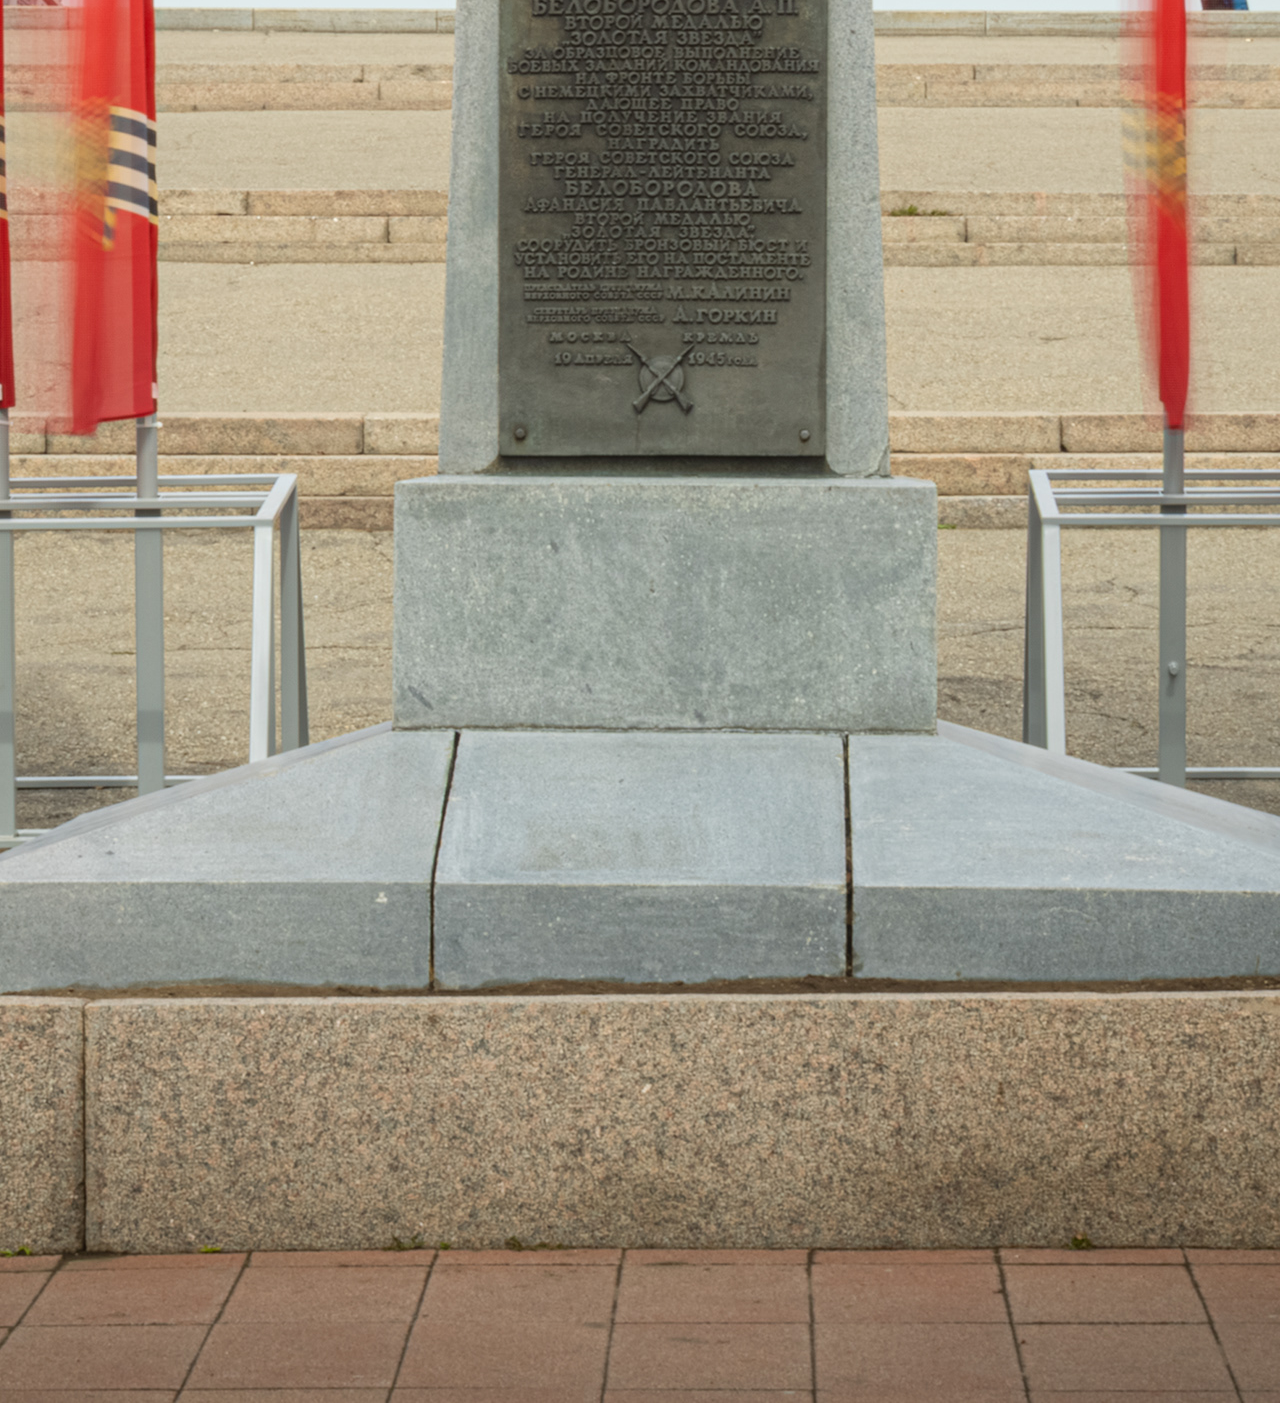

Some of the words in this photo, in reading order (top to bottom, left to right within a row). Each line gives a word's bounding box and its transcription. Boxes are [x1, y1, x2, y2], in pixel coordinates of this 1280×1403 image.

[565, 15, 644, 30] ВТОРОЙ
[652, 15, 763, 30] МЕДАЛЬЮ
[524, 48, 550, 60] ЗА
[556, 48, 665, 60] ОБРАЗЦОВОЕ
[674, 48, 800, 60] ВЫПОЛНЕНИЕ
[508, 60, 579, 73] БОЕВЫХ
[586, 60, 668, 73] ЗАДАНИЙ
[675, 60, 820, 73] КОМАНДОВАНИЯ
[576, 73, 598, 85] НА
[606, 73, 676, 85] ФРОНТЕ
[682, 73, 751, 85] БОРЬБЫ
[518, 86, 530, 99] С
[534, 86, 651, 99] НЕМЕЦКИМИ
[660, 86, 813, 99] ЗАХВАТЧИКАМИ,
[586, 99, 672, 111] ДАЮЩЕЕ
[681, 99, 738, 111] ПРАВО
[544, 112, 570, 124] НА
[581, 112, 697, 124] ПОЛУЧЕНИЕ
[707, 112, 781, 124] ЗВАНИЯ
[518, 124, 581, 138] ГЕРОЯ
[597, 124, 720, 138] СОВЕТСКОГО
[735, 124, 808, 138] СОЮЗА,
[608, 138, 719, 151] НАГРАДИТЬ
[531, 153, 590, 166] ГЕРОЯ
[599, 153, 720, 166] СОВЕТСКОГО
[729, 153, 794, 166] СОЮЗА
[565, 181, 758, 198] БЕЛОБОРОДОВА
[525, 199, 625, 213] АФАНАСИЯ
[574, 213, 644, 226] ВТОРОЙ
[654, 213, 750, 226] МЕДАЛЬЮ
[518, 240, 618, 252] СООРУДИТЬ
[627, 240, 729, 252] БРОНЗОВЫЙ
[739, 240, 790, 252] БЮСТ
[515, 253, 621, 267] УСТАНОВИТЬ
[628, 253, 659, 267] ЕГО
[666, 253, 689, 267] НА
[694, 253, 810, 267] ПОСТАМЕНТЕ
[524, 267, 549, 280] НА
[557, 267, 628, 280] РОДИНЕ
[637, 267, 803, 280] НАГРАЖДЕННОГО.
[640, 292, 663, 301] СССР
[549, 331, 631, 343] МОСКВА
[682, 331, 759, 343] КРЕМЛЬ
[689, 353, 725, 367] 1945
